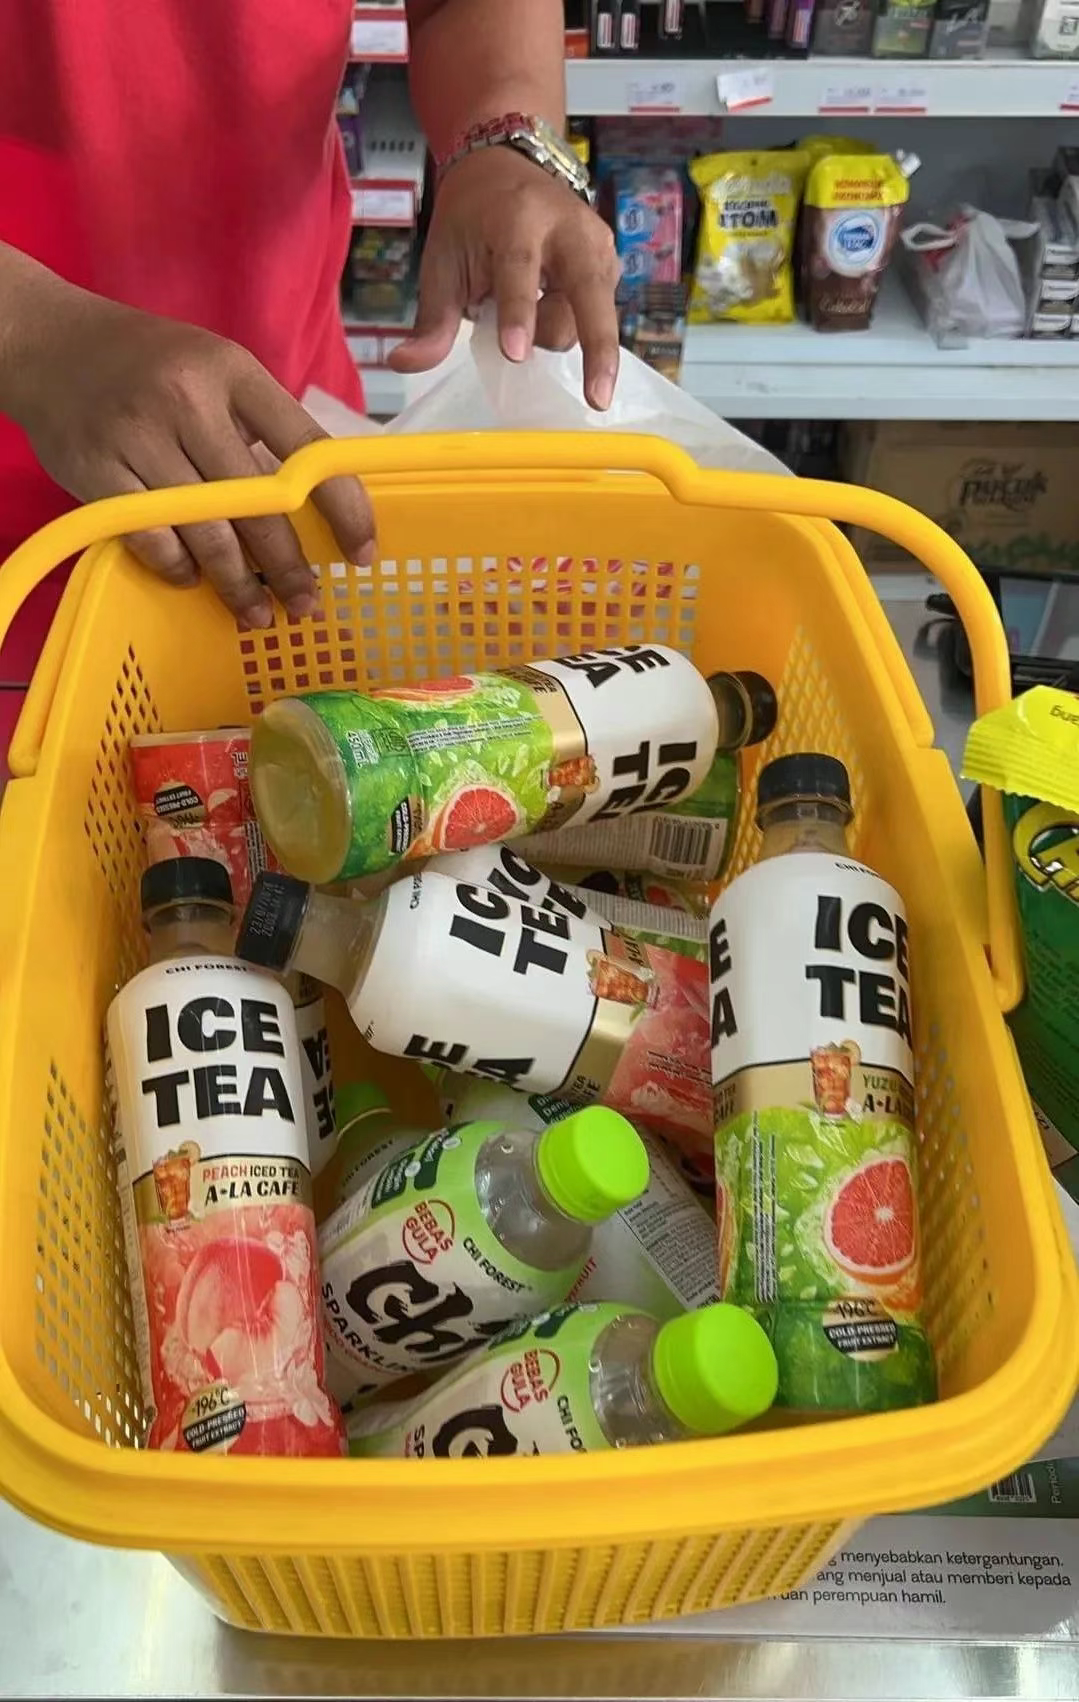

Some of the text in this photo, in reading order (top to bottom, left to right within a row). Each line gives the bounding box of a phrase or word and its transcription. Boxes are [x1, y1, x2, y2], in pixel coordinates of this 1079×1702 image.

[587, 741, 649, 822] TE
[627, 741, 698, 815] IC
[815, 895, 910, 984] ICE
[194, 964, 247, 972] FOREST
[145, 996, 286, 1063] ICE
[805, 965, 912, 1053] TEA
[142, 1064, 296, 1128] TEA
[203, 1165, 300, 1184] PEACH ICED TEA
[405, 1217, 438, 1260] GULA
[414, 1201, 454, 1251] BEBAS
[463, 1237, 526, 1293] CHI FOREST
[510, 1362, 531, 1408] GULA
[524, 1350, 549, 1402] BEBAS
[557, 1395, 574, 1425] CHI
[814, 1569, 1071, 1590] ang menjual atau memberi kepada
[841, 1551, 943, 1567] menyebabkan
[946, 1552, 1064, 1570] ketergantungan.
[813, 1589, 898, 1606] perempuan
[901, 1589, 947, 1605] hamil.
